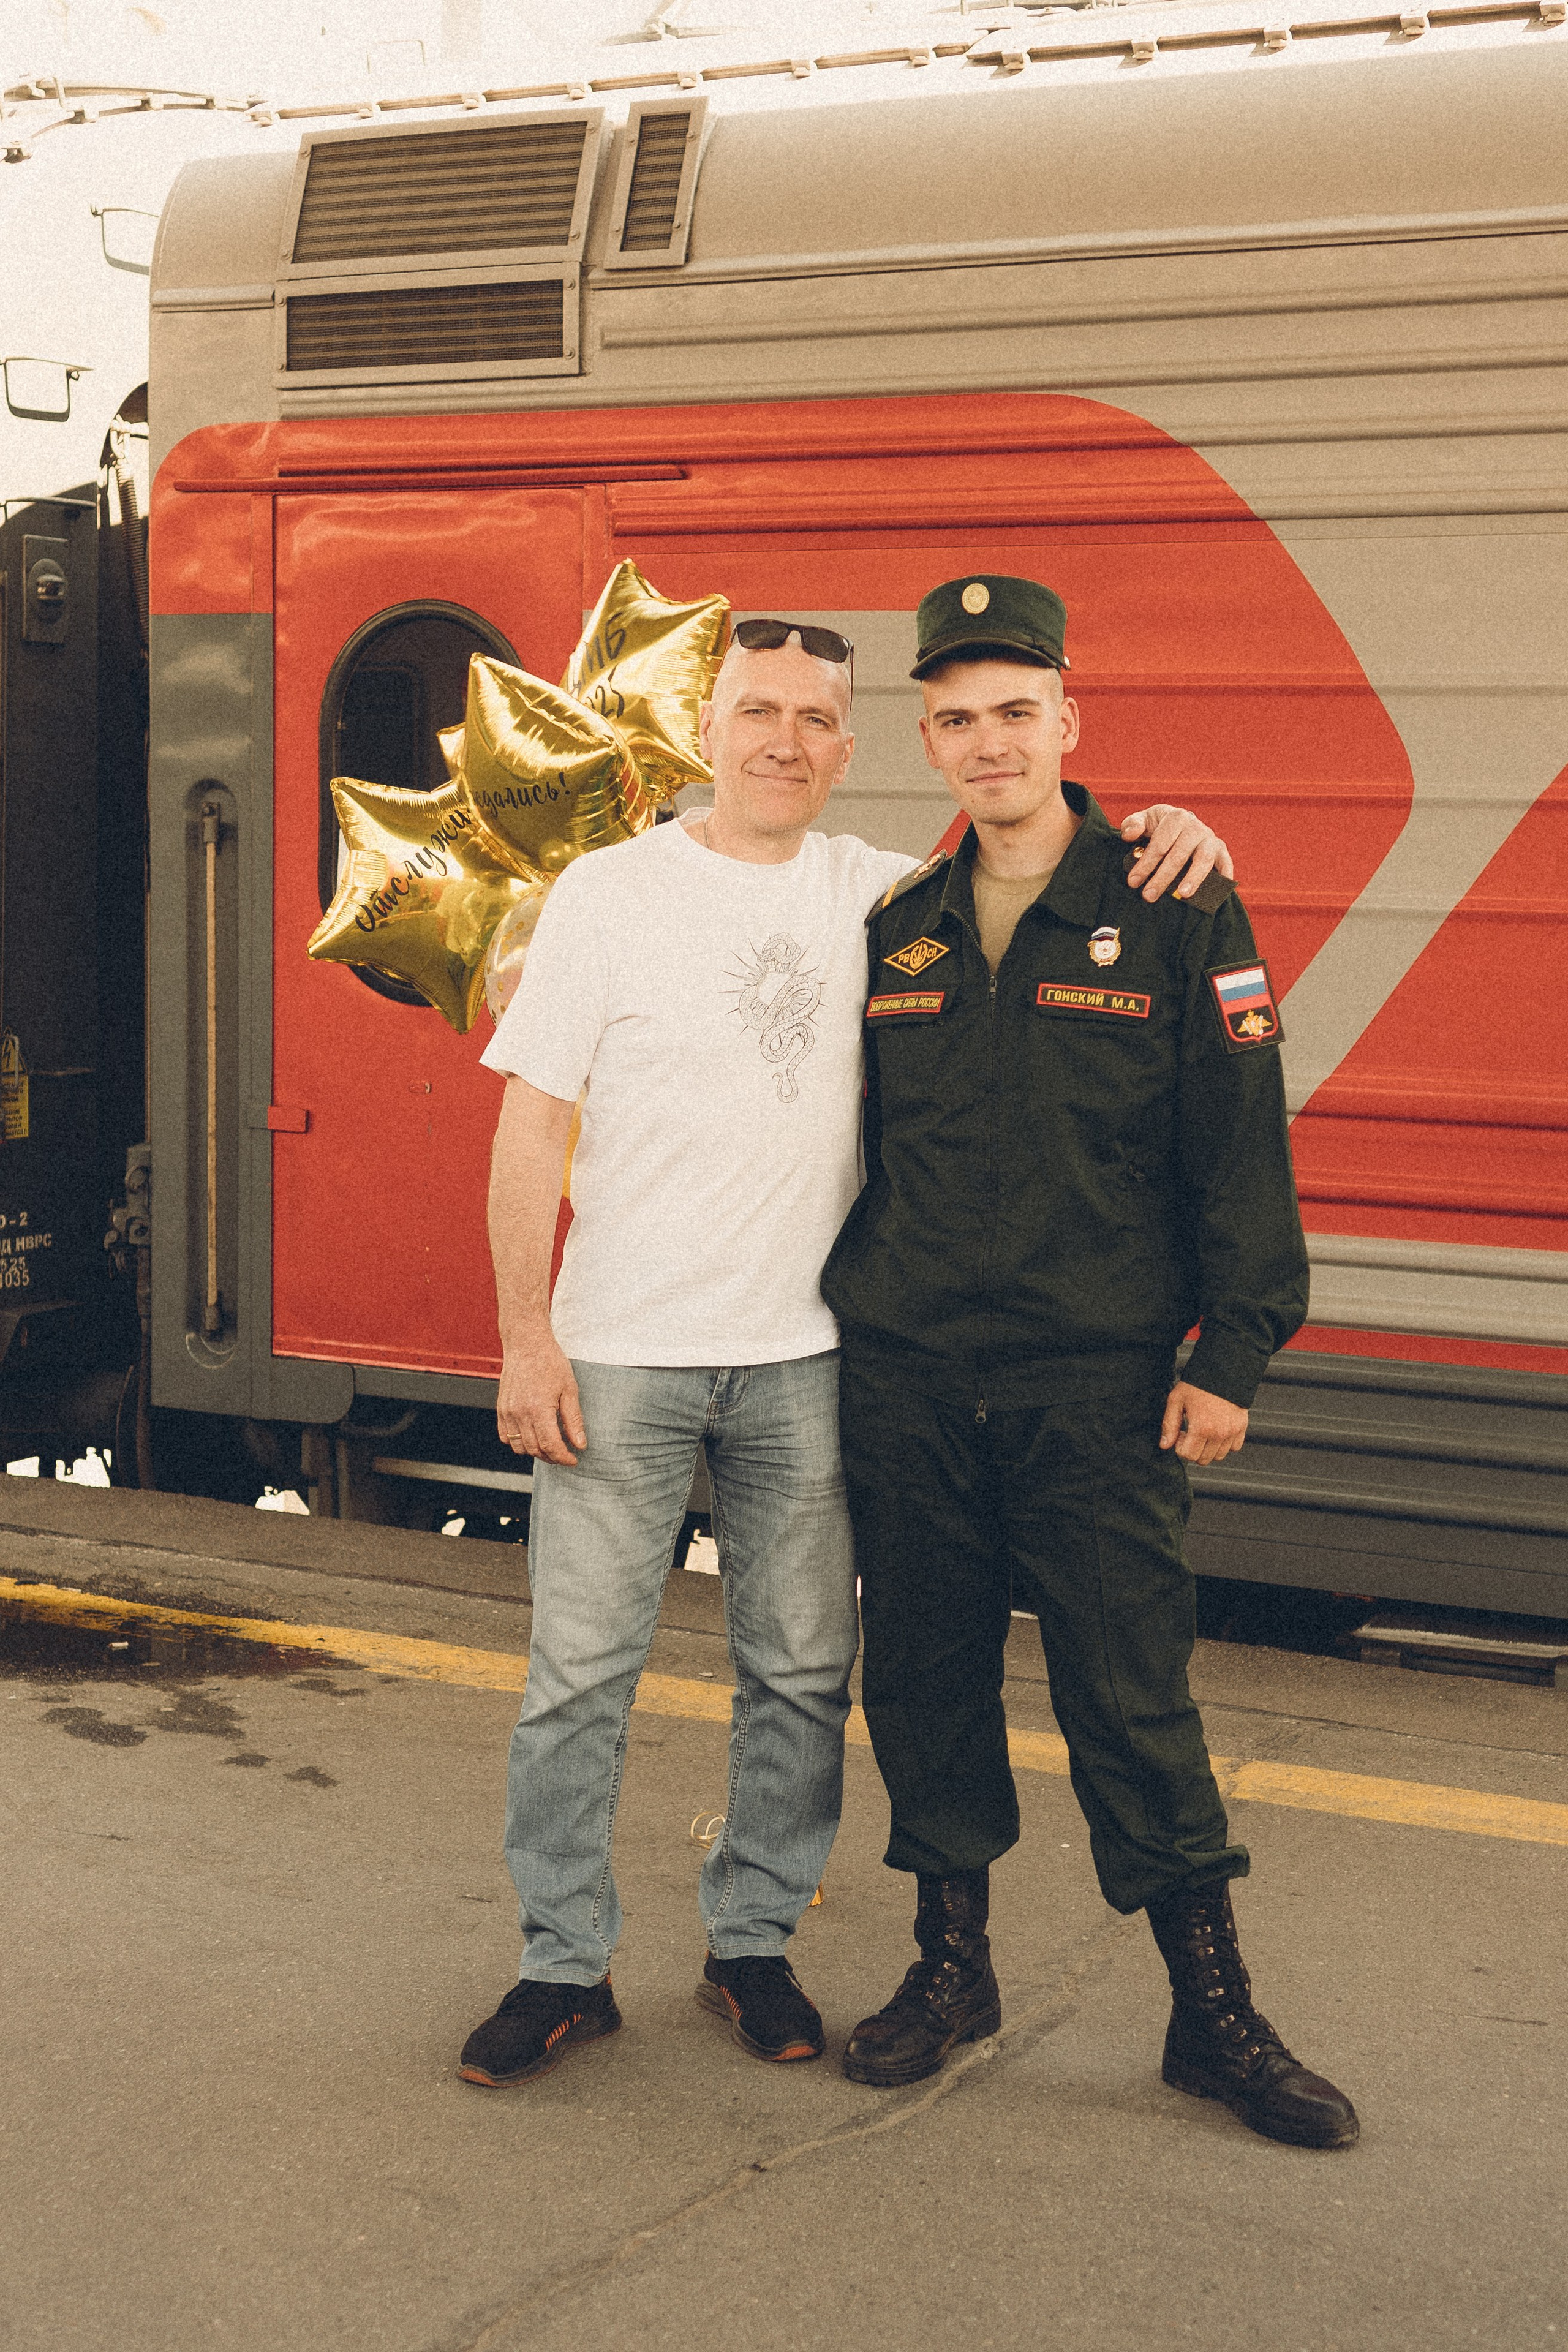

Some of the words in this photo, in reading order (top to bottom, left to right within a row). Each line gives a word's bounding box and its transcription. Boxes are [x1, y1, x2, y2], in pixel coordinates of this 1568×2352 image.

[355, 809, 472, 933] Отслужи
[918, 997, 941, 1008] РОССИИ
[1046, 989, 1104, 1006] ГОНСКИЙ
[1111, 996, 1140, 1011] М.А.
[15, 1233, 52, 1251] НВРС
